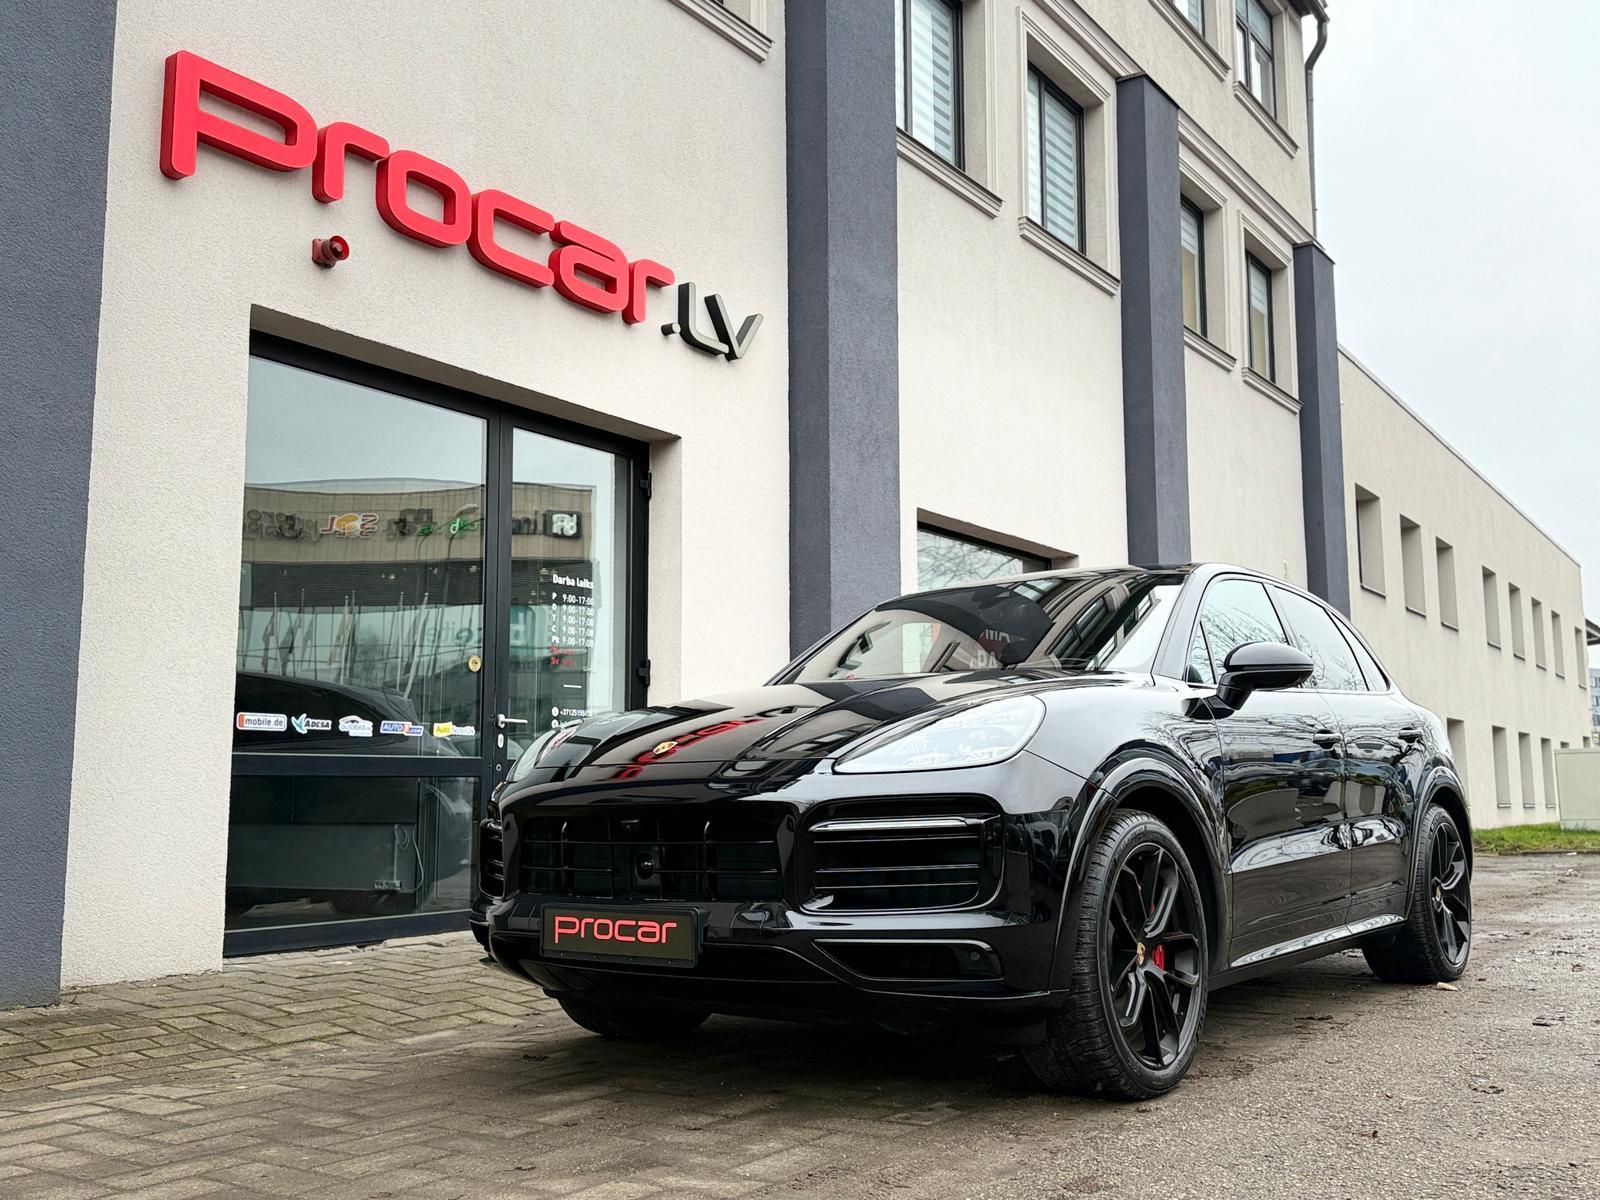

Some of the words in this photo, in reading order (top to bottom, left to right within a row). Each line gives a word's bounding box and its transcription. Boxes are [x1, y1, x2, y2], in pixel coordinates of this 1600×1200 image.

[552, 573, 576, 587] Darba
[576, 577, 595, 589] laiks
[245, 717, 284, 728] mobile.de
